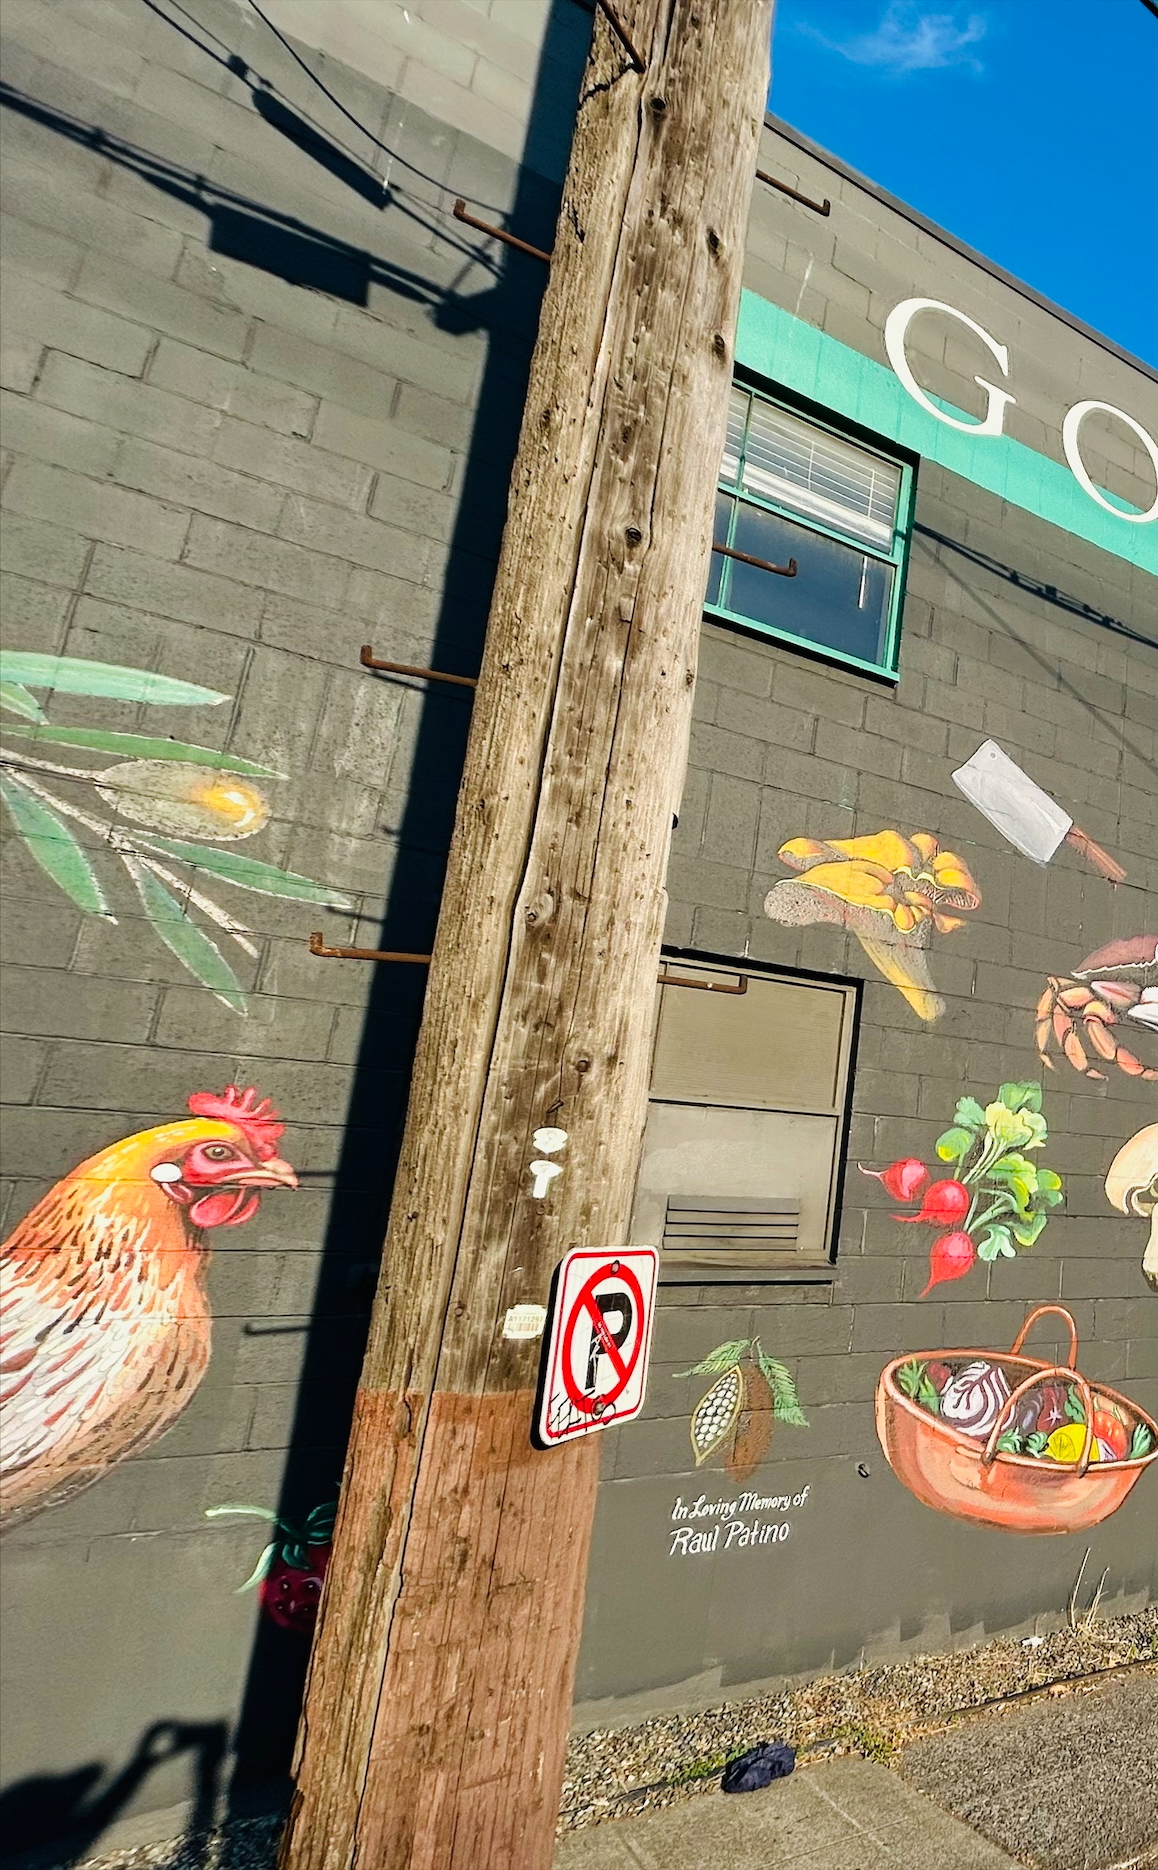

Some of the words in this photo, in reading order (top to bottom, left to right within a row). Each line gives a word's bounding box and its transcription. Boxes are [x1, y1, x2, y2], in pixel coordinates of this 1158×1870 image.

[671, 1496, 689, 1520] In
[689, 1494, 737, 1521] Loving
[738, 1491, 792, 1511] Memory
[792, 1485, 811, 1507] of
[669, 1525, 720, 1556] Raul
[723, 1519, 791, 1549] Patino
